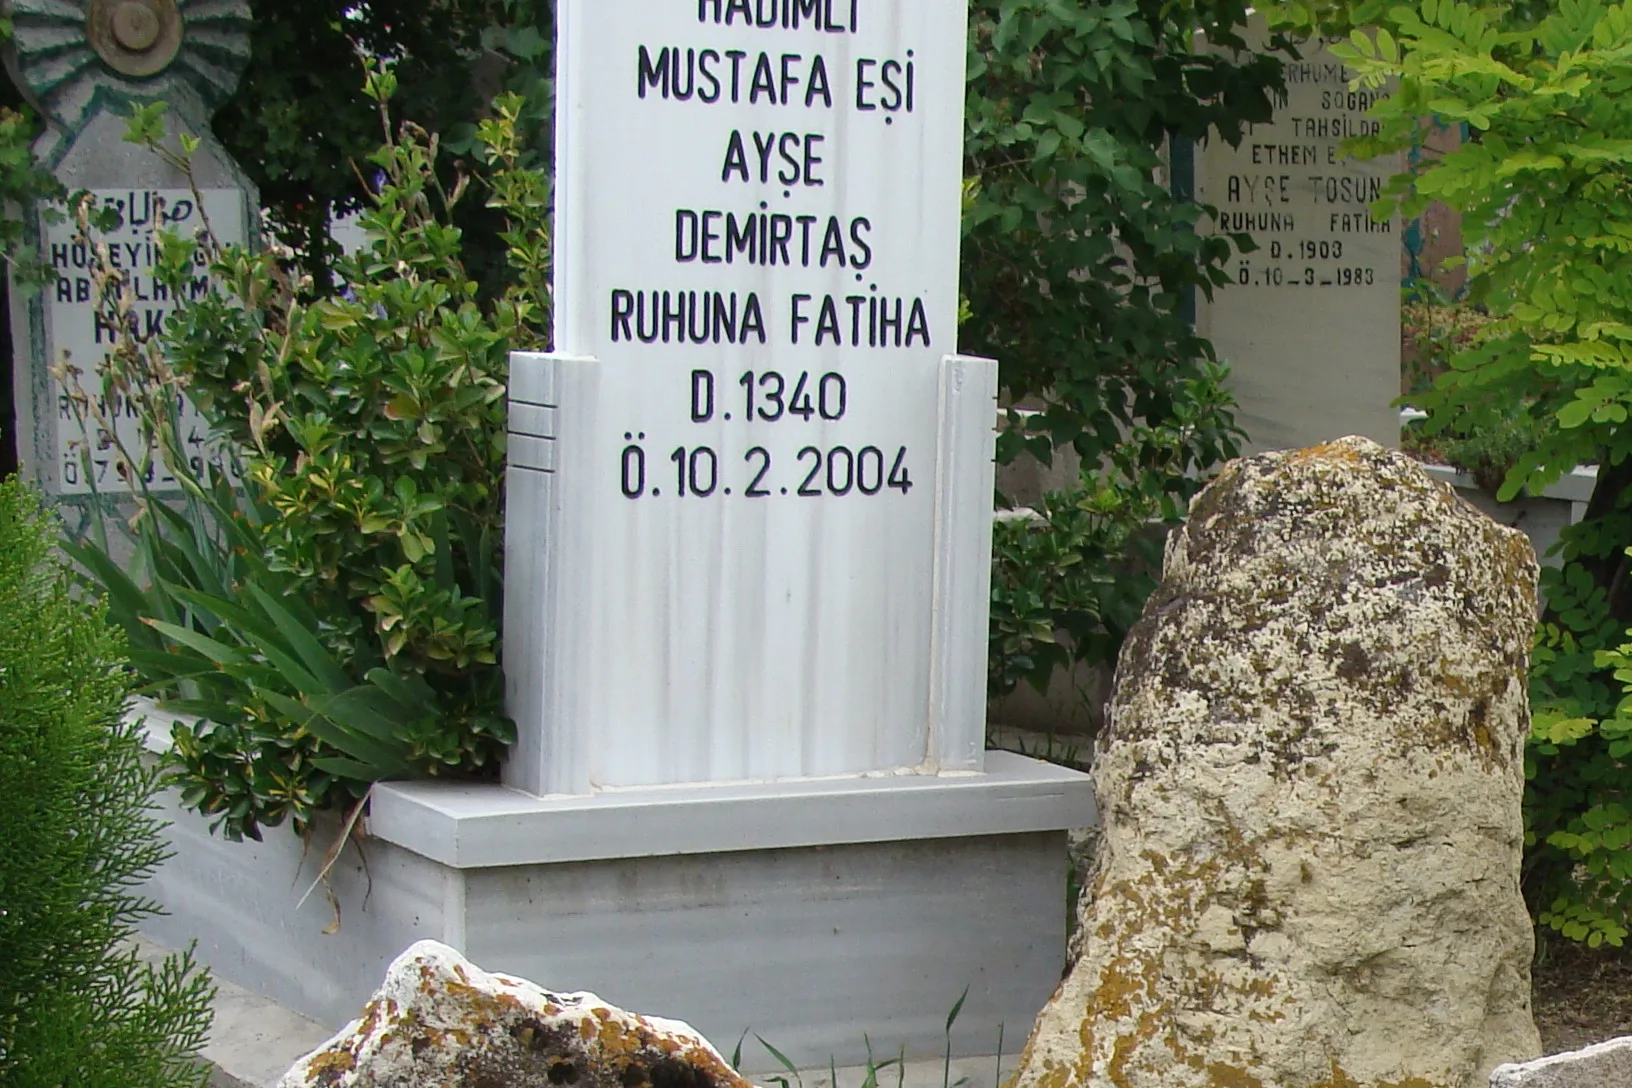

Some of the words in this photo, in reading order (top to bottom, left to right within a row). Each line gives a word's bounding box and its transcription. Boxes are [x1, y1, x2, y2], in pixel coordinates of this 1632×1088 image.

[637, 45, 832, 109] MUSTAFA
[856, 49, 914, 125] EŞİ
[1291, 113, 1386, 138] TAHSİLDA
[722, 129, 825, 198] AYŞE
[1252, 144, 1316, 165] ETHEM
[1227, 175, 1290, 207] AYŞE
[1308, 175, 1381, 203] TOSUN
[676, 200, 872, 282] DEMİRTAŞ
[1220, 211, 1294, 232] RUHUNA
[1270, 239, 1343, 259] D.1903
[610, 289, 766, 344] RUHUNA
[790, 283, 931, 348] FATİHA
[691, 369, 847, 423] D.1340
[620, 431, 914, 499] Ö.10.2.2004
